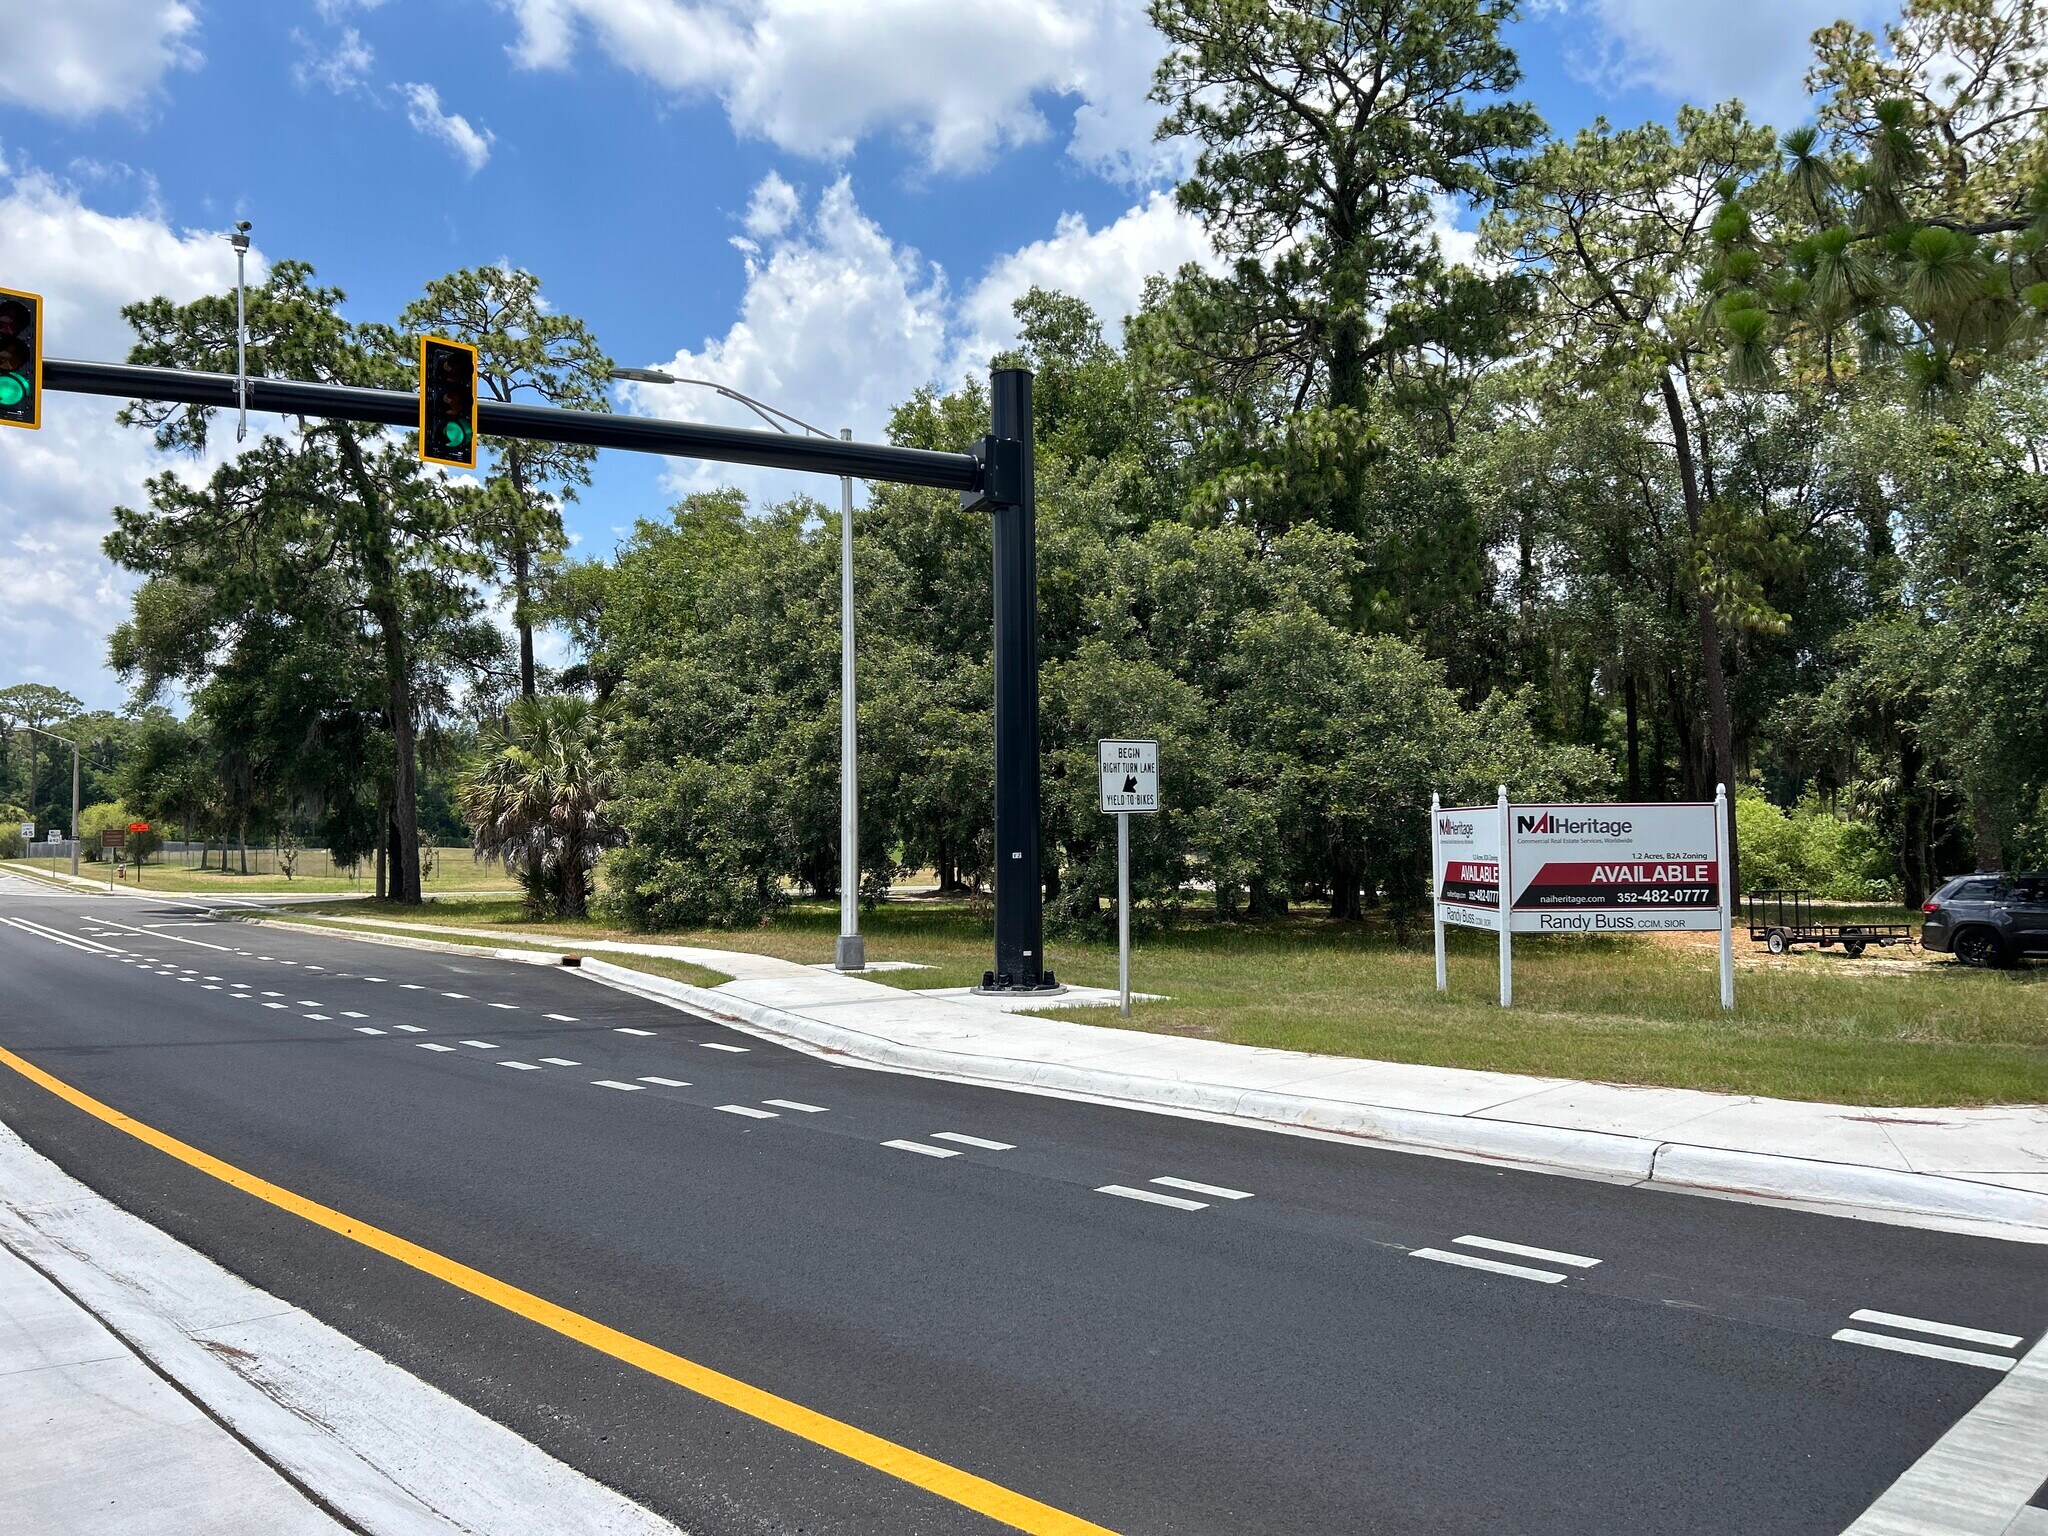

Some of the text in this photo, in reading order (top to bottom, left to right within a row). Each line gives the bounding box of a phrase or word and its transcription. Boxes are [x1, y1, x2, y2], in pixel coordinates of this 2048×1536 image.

[1118, 747, 1140, 758] BEGIN
[1103, 762, 1155, 773] RIGHT TURN LANE
[1107, 794, 1154, 805] YIELD TO BIKES
[1461, 865, 1498, 882] AVAILABLE
[1591, 865, 1709, 882] AVAILABLE
[1540, 889, 1709, 905] naiheritage.com 352-482-0777
[1447, 907, 1461, 925] Randy
[1541, 914, 1591, 931] Randy
[1638, 920, 1662, 928] CCIM,
[1664, 919, 1686, 928] SIOR
